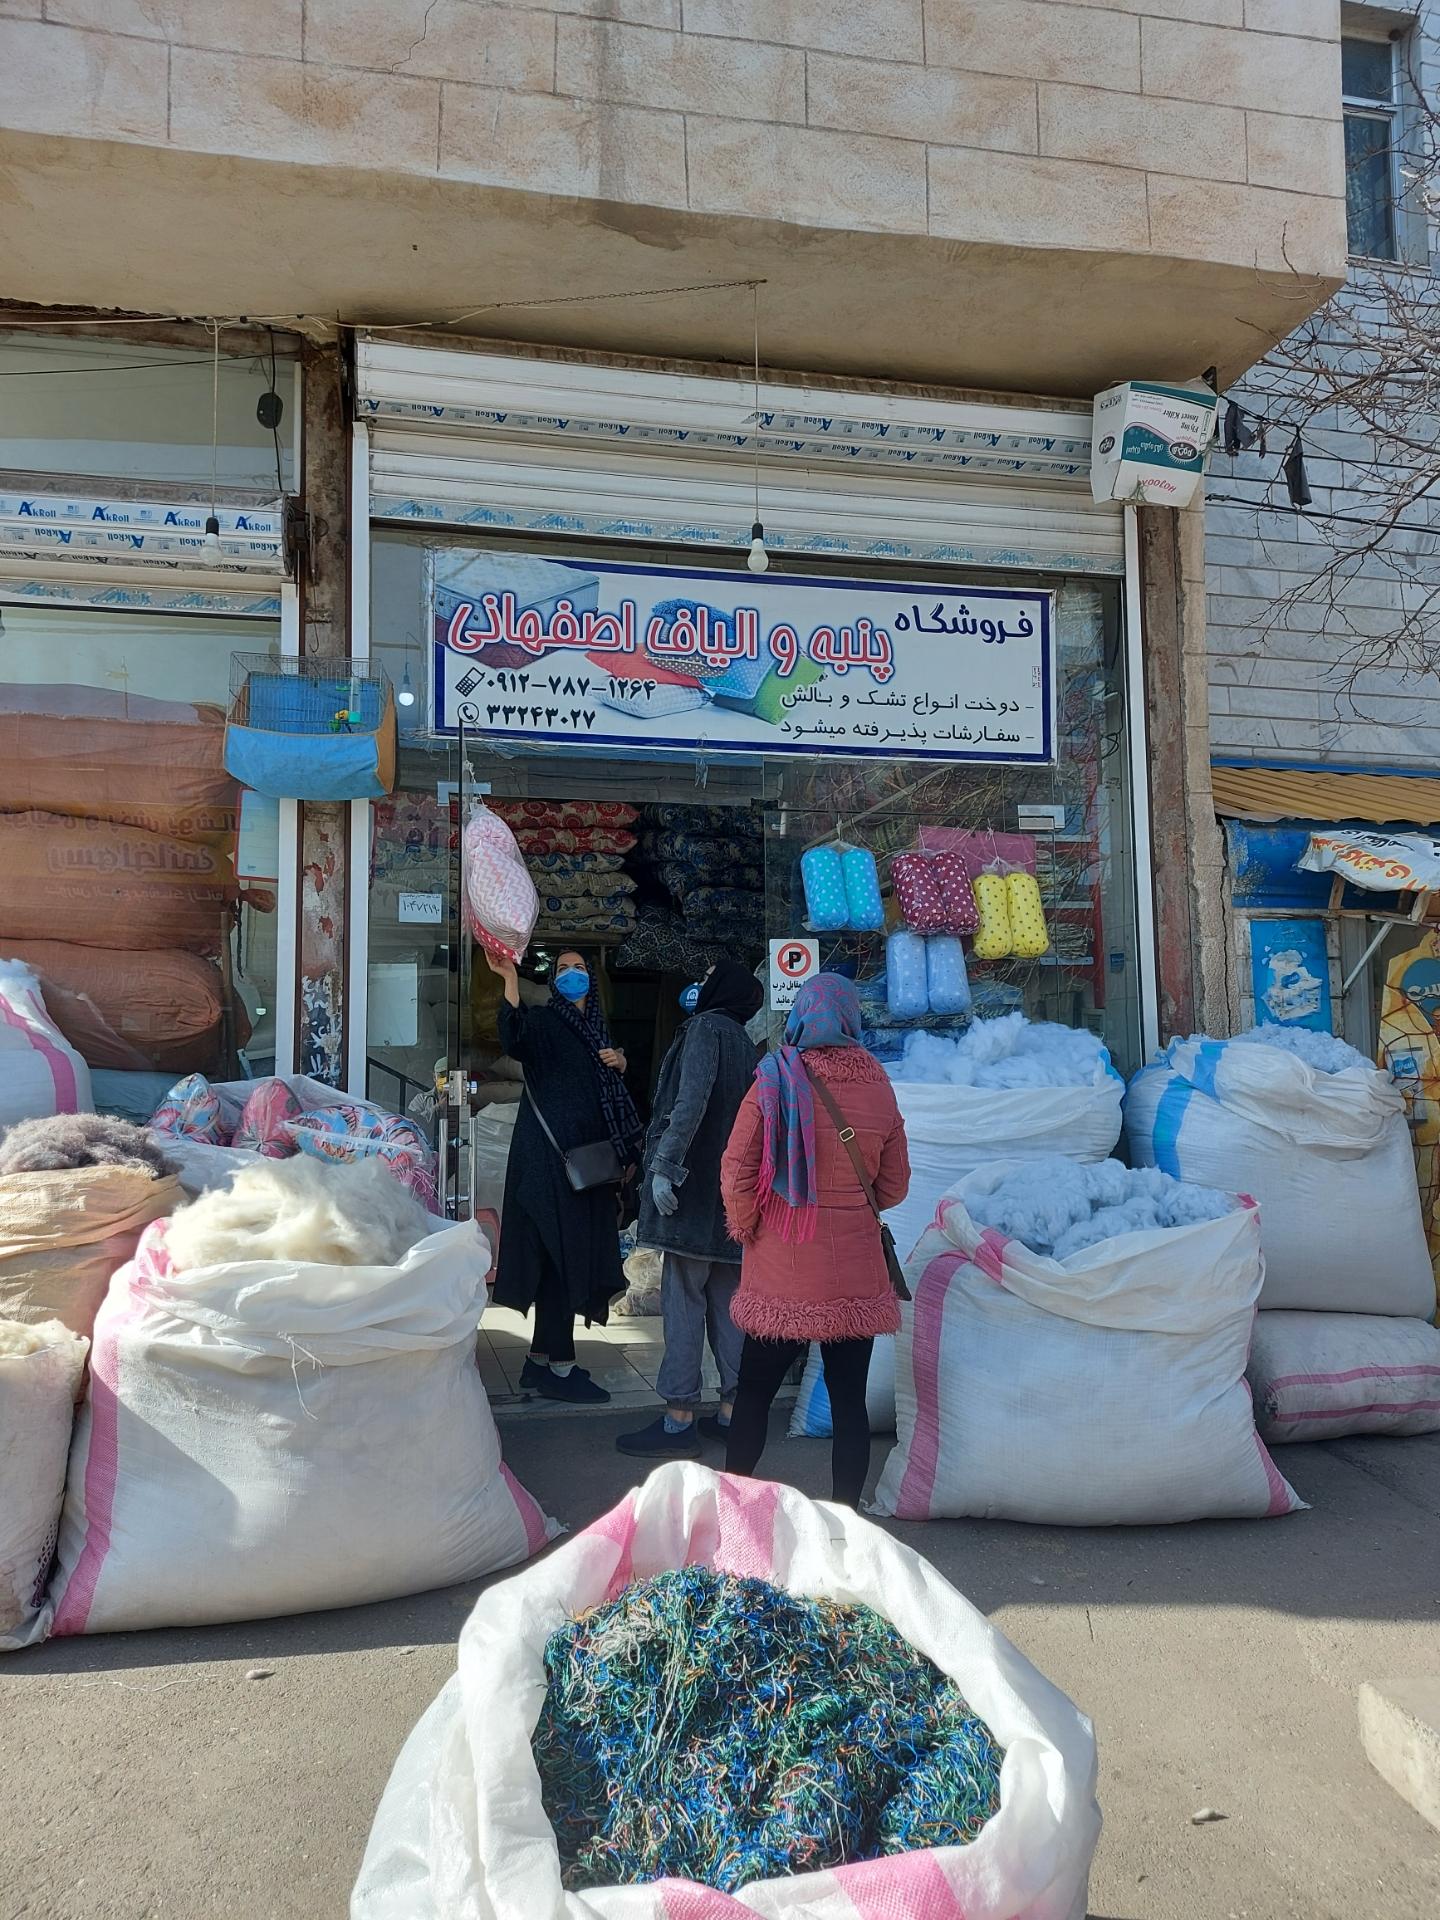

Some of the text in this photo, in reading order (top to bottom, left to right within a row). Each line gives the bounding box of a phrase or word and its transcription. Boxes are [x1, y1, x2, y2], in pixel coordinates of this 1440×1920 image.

[18, 501, 56, 518] AkRoll
[92, 505, 129, 523] AkRoll
[164, 510, 201, 527] AkRoll
[235, 515, 271, 531] AkRoll
[34, 528, 72, 544] AkRoll
[107, 533, 145, 549] AkRoll
[448, 591, 1035, 684] فروشگاه پنبه و الیاف اصفهانی
[486, 671, 657, 700] ۰۹۱۲-۷۸۷-۱۲۶۴
[781, 685, 834, 708] بالش
[840, 695, 850, 709] و
[856, 689, 907, 708] تشک
[912, 692, 959, 715] انواع
[486, 704, 597, 729] ۳۳۲۴۳۰۲۷
[964, 699, 1020, 720] دوخت
[780, 719, 847, 737] میشود
[852, 720, 928, 745] پذیرفته
[932, 725, 1021, 745] سفارشات
[788, 951, 802, 969] P
[772, 980, 786, 991] درب
